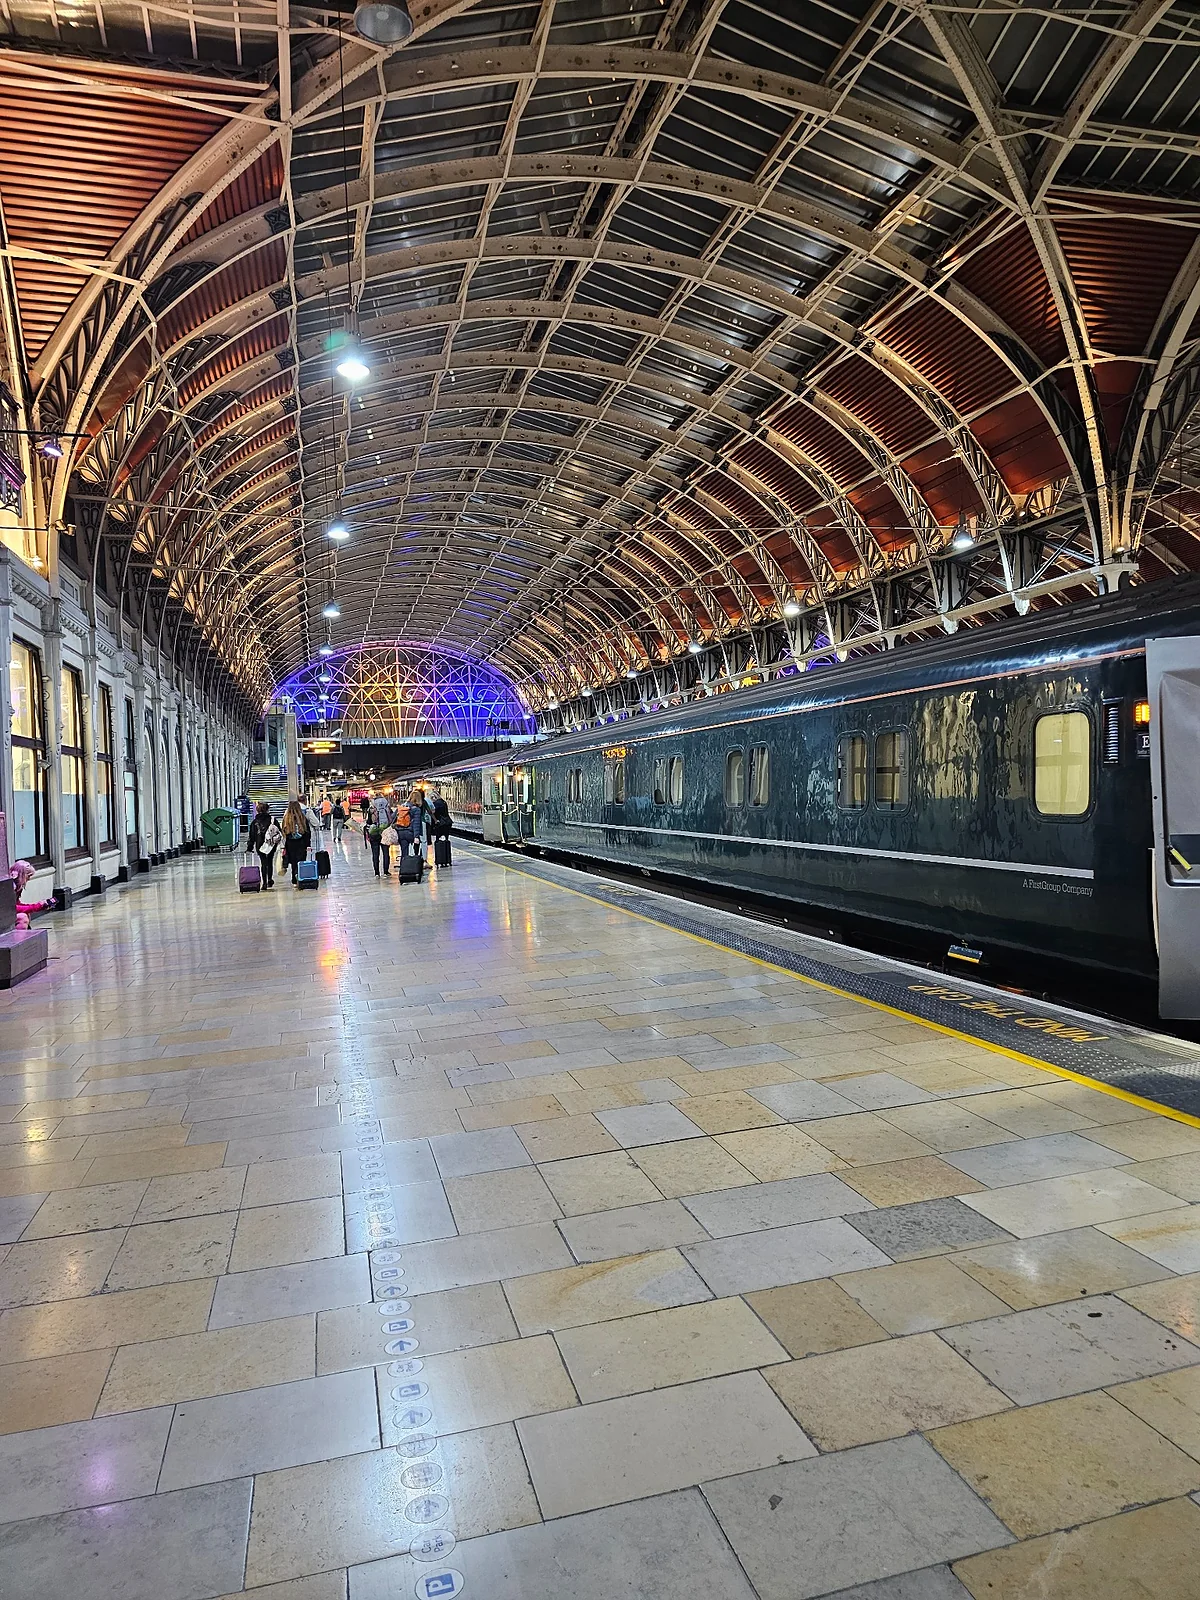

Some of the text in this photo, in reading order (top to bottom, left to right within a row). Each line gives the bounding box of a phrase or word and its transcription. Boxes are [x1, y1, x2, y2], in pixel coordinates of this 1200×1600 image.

[1022, 878, 1093, 897] A FirstGroup Company
[907, 984, 1110, 1043] MIND THE GAP
[401, 1386, 419, 1395] P
[421, 1540, 432, 1553] Car
[433, 1535, 444, 1553] Park
[428, 1579, 452, 1593] P
